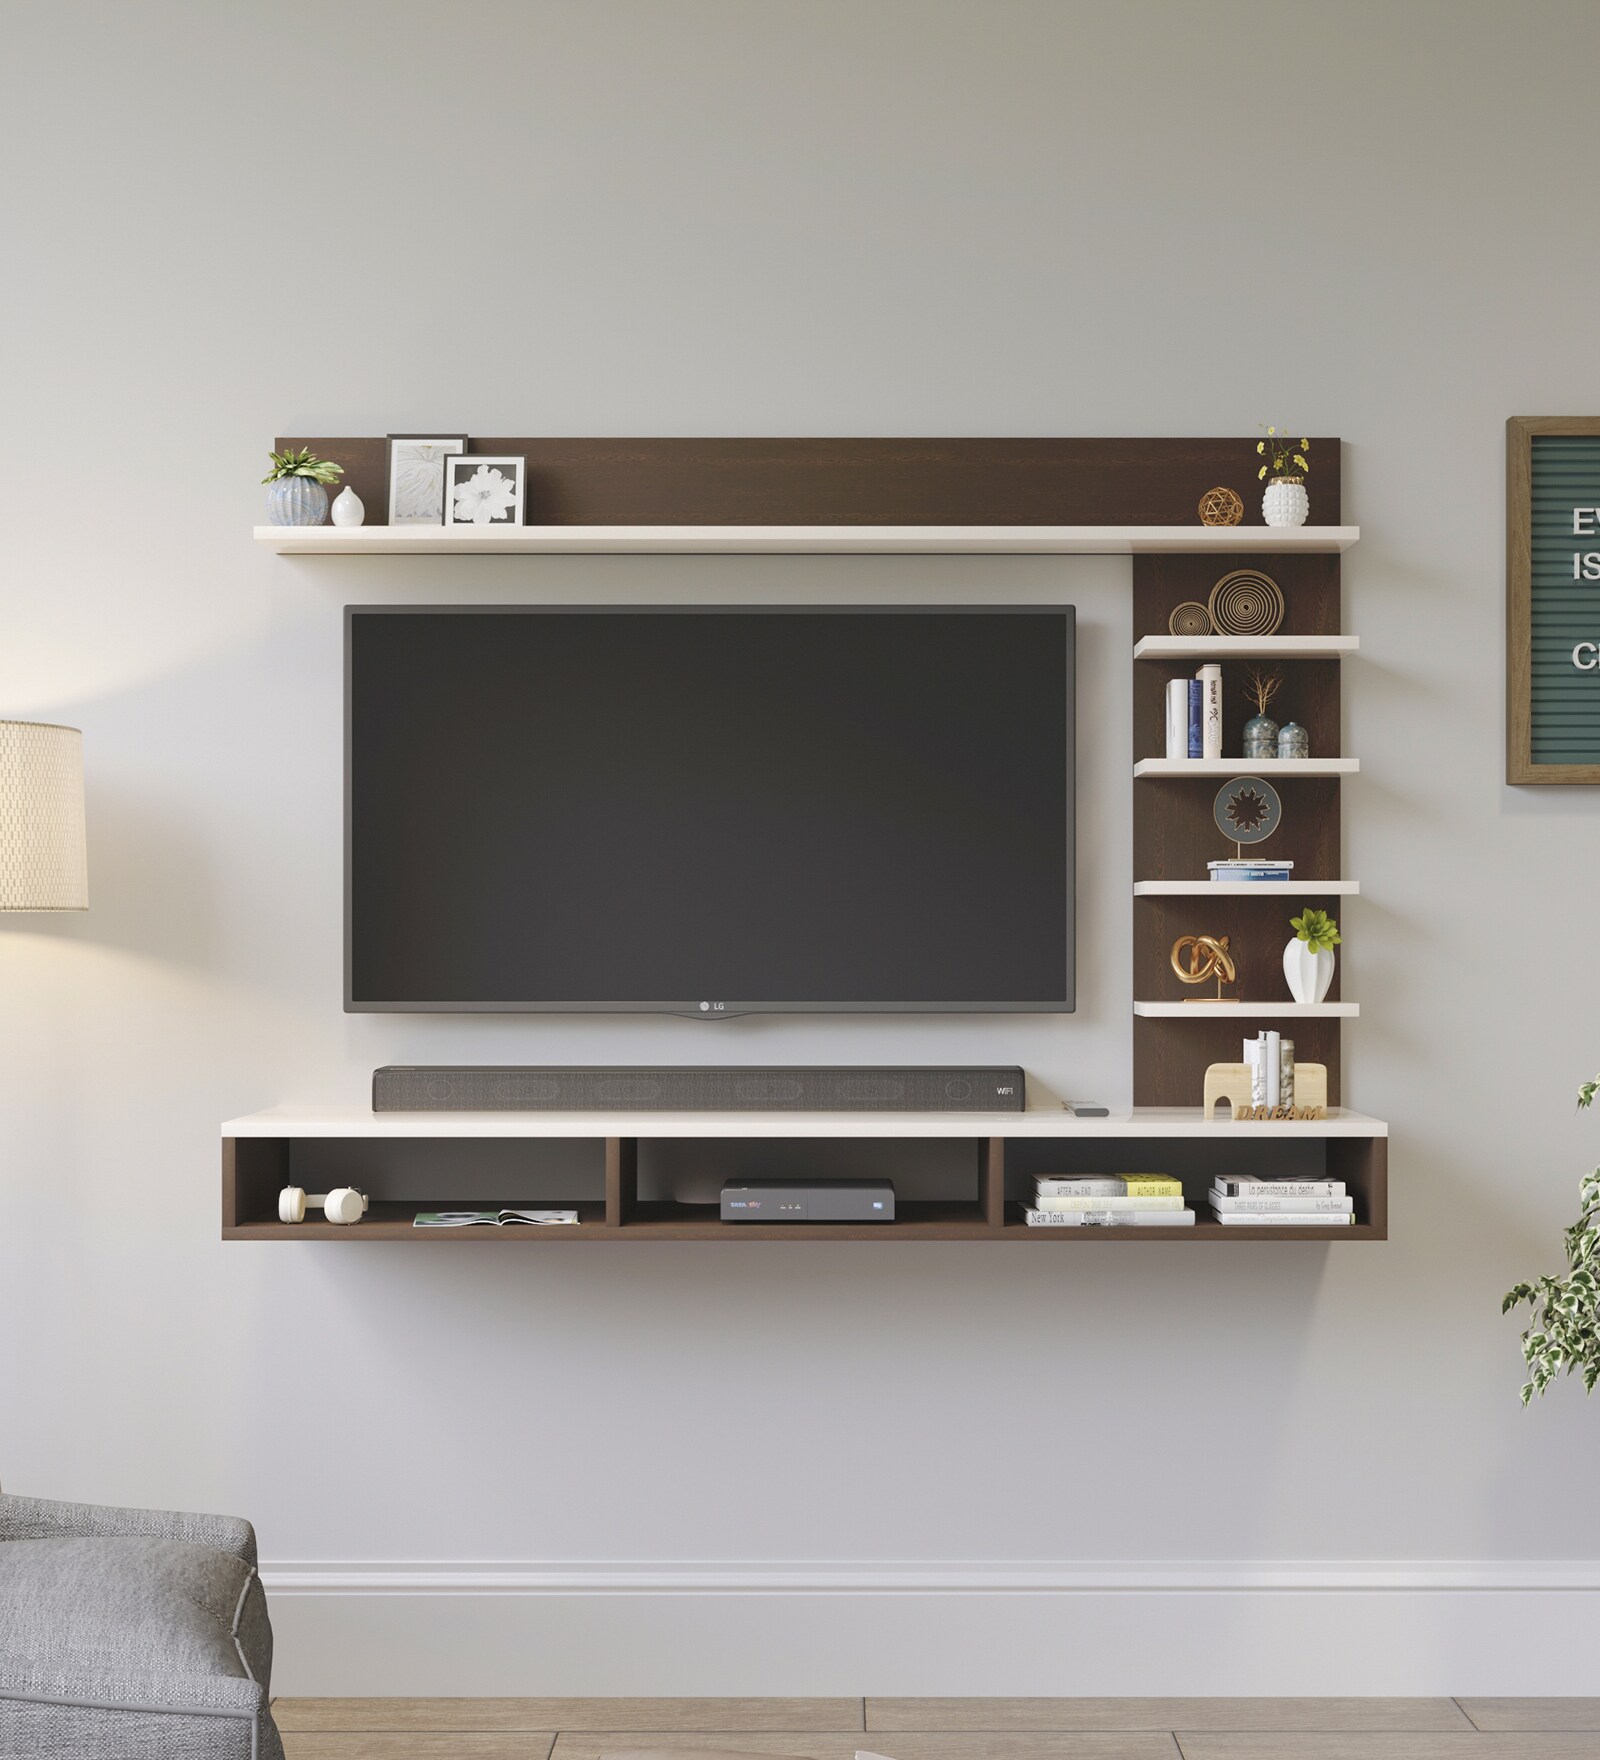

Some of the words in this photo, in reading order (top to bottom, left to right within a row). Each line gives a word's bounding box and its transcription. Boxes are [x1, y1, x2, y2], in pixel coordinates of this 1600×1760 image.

[1573, 507, 1600, 535] E
[1572, 641, 1600, 670] C
[713, 1002, 725, 1010] LG
[1235, 1105, 1323, 1120] DREAM
[1031, 1212, 1046, 1223] New
[1048, 1211, 1065, 1223] York
